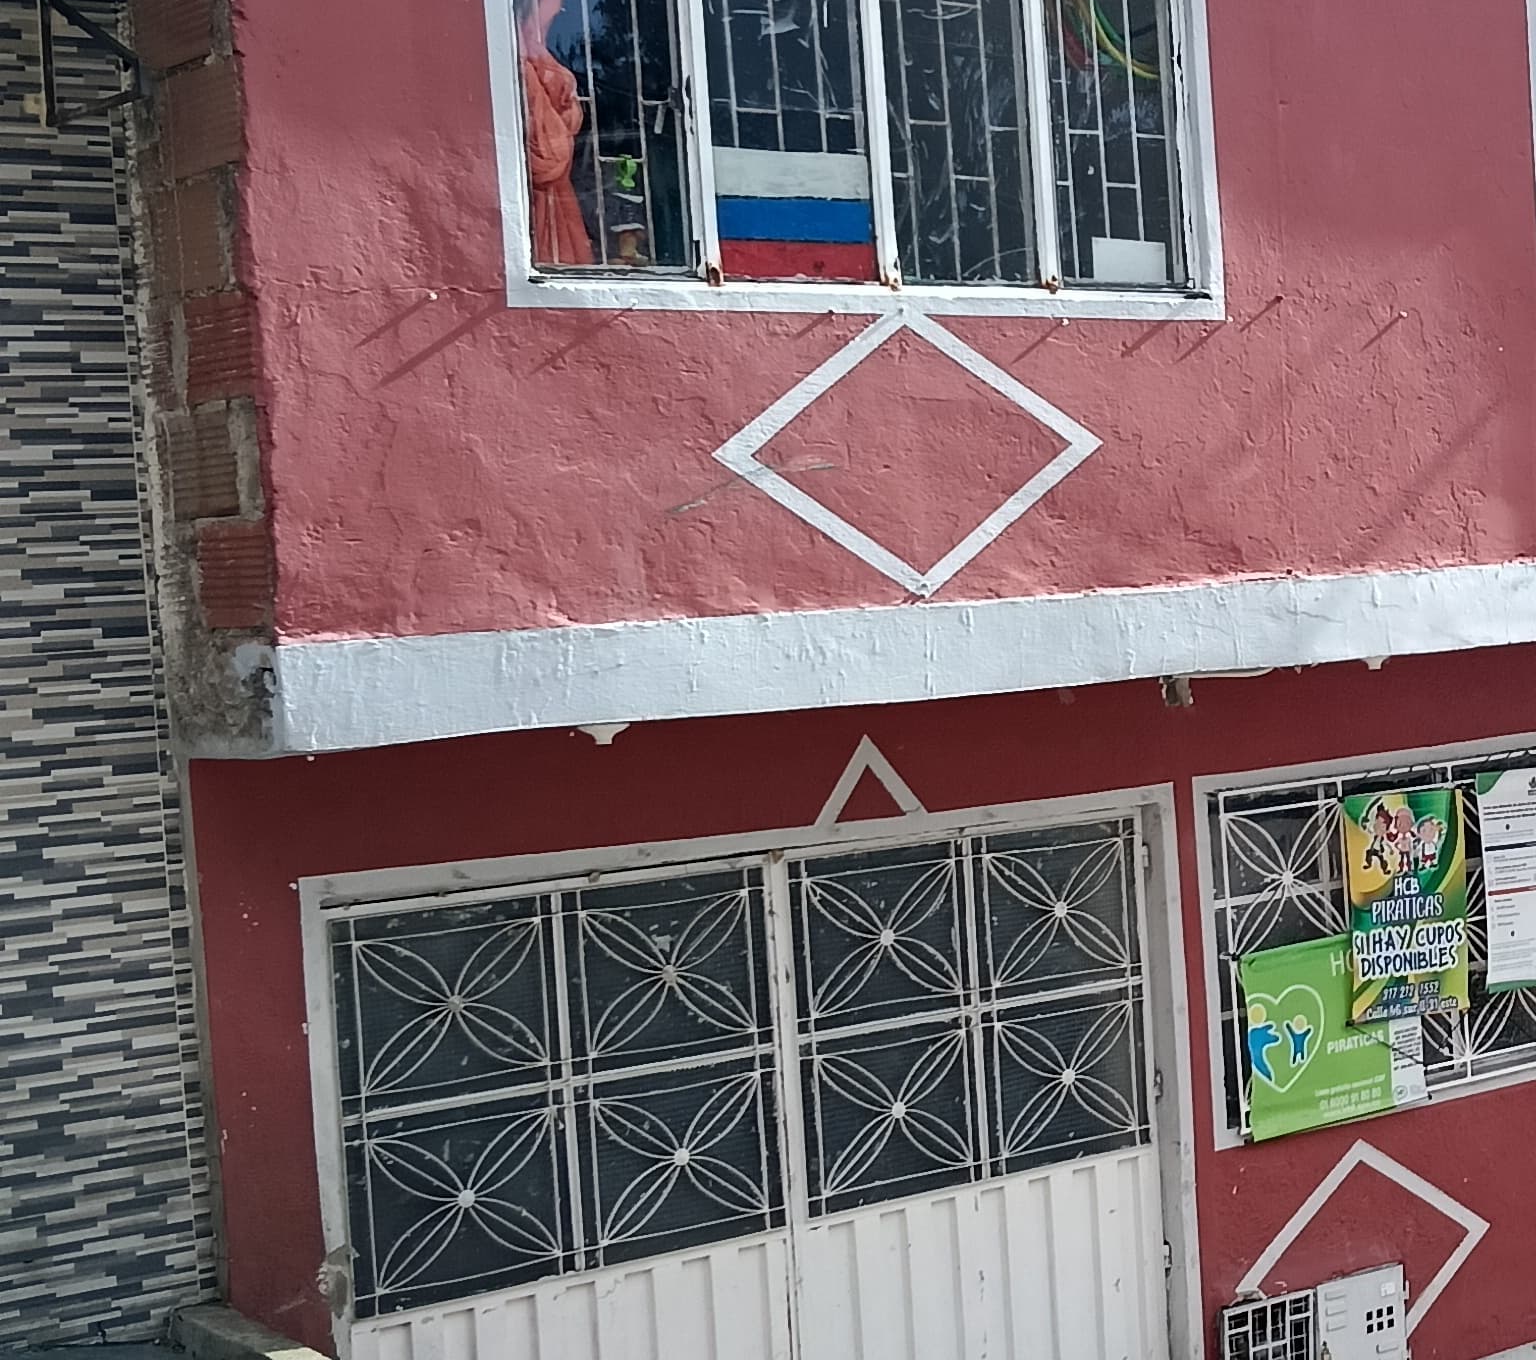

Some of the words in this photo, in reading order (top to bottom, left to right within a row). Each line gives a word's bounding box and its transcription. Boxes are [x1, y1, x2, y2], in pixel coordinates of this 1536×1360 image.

[1394, 876, 1420, 897] HCB
[1372, 894, 1444, 924] PIRATICAS
[1372, 927, 1409, 954] HAY
[1415, 922, 1463, 947] CUPOS
[1360, 945, 1456, 978] DISPONIBLES
